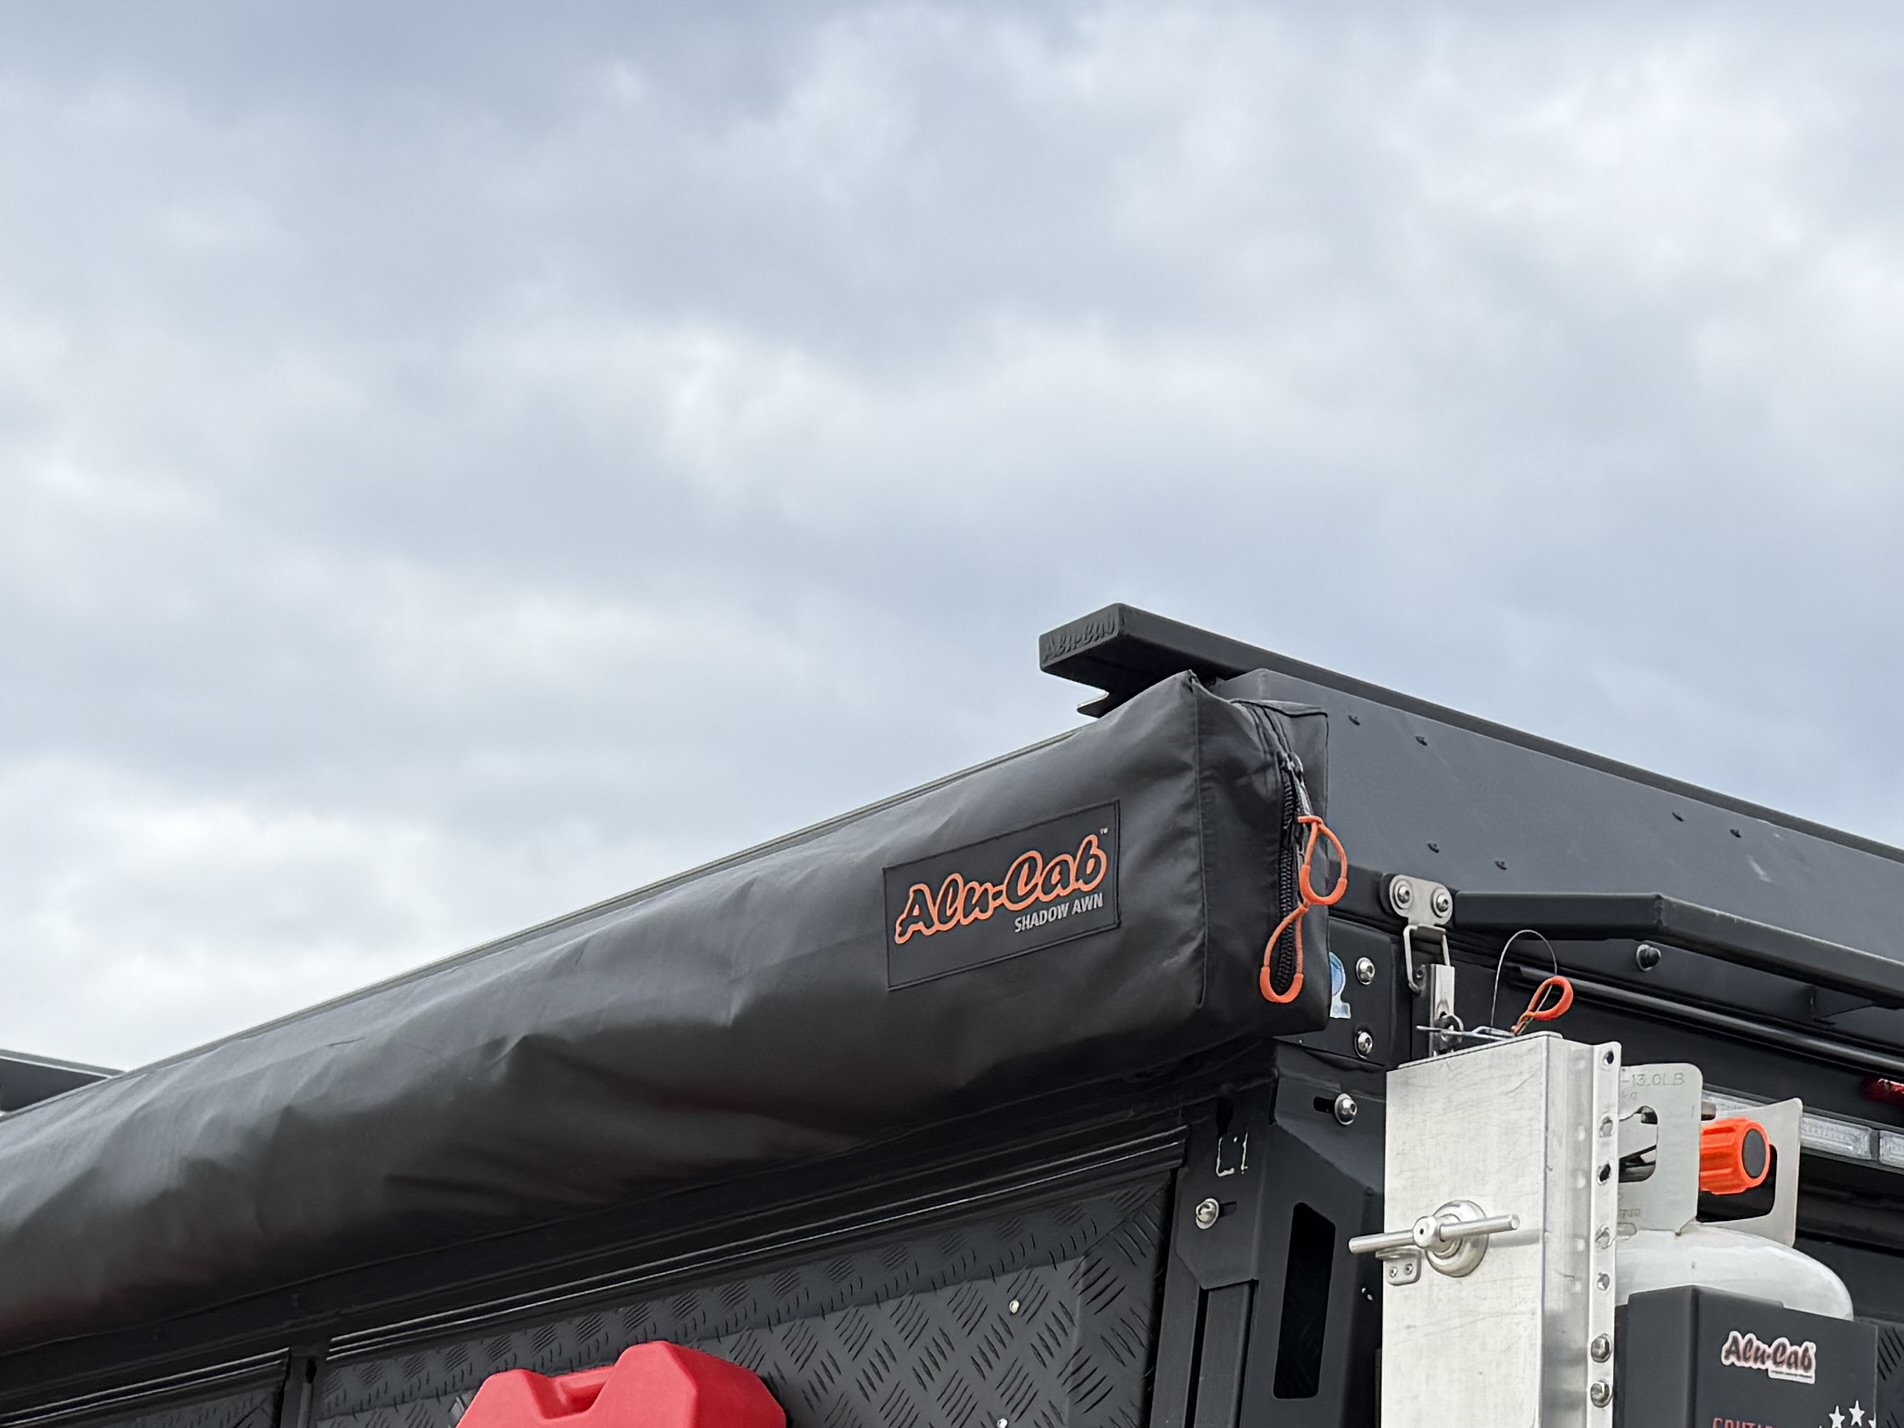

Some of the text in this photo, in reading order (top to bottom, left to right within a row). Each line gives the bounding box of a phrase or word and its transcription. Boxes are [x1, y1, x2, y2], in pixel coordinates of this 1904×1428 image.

[895, 833, 1108, 945] Alu-Cab
[1014, 893, 1104, 933] SHADOW AWN
[1723, 1334, 1814, 1373] Alu-Cab
